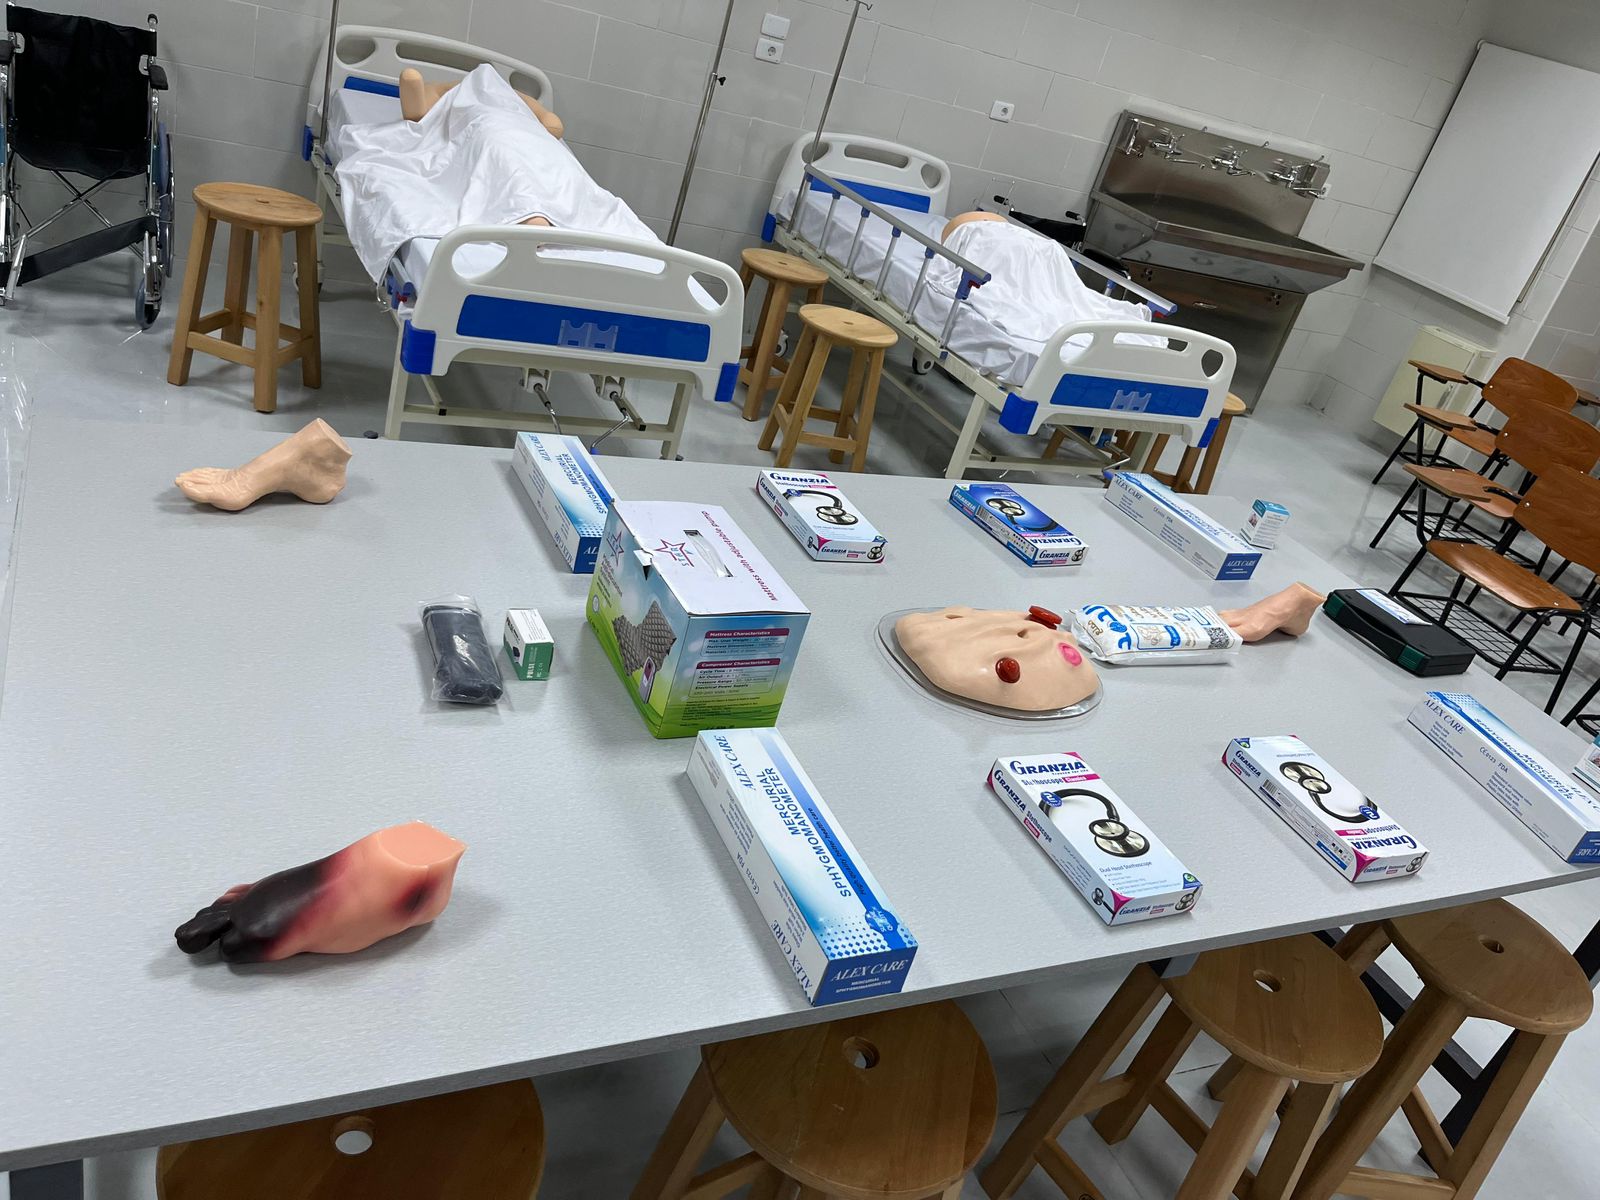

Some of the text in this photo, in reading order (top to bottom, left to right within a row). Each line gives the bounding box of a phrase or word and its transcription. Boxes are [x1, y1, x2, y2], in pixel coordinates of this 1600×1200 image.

[552, 454, 580, 484] MERCURIAL
[560, 453, 608, 513] SPHYGMOMANOMETER
[770, 472, 829, 484] GRANZIA
[1113, 477, 1143, 501] ALEX CARE
[1039, 550, 1070, 559] GRANZIA
[1423, 697, 1466, 735] ALEX CARE
[712, 734, 756, 791] ALEX CARE
[1010, 761, 1086, 775] GRANZIA
[1234, 748, 1262, 777] GRANZIA
[1497, 761, 1509, 774] FDA
[753, 771, 801, 835] MERCURIAL
[993, 766, 1027, 811] GRANZIA
[763, 767, 852, 897] SPHYGMOMANOMETER
[1026, 809, 1052, 844] Stethoscope
[1351, 834, 1418, 850] GRANZIA
[736, 850, 745, 869] FDA
[1119, 905, 1151, 916] GRANZIA
[770, 916, 792, 958] CARE
[790, 952, 812, 994] ALEX
[830, 958, 908, 981] ALEX CARE
